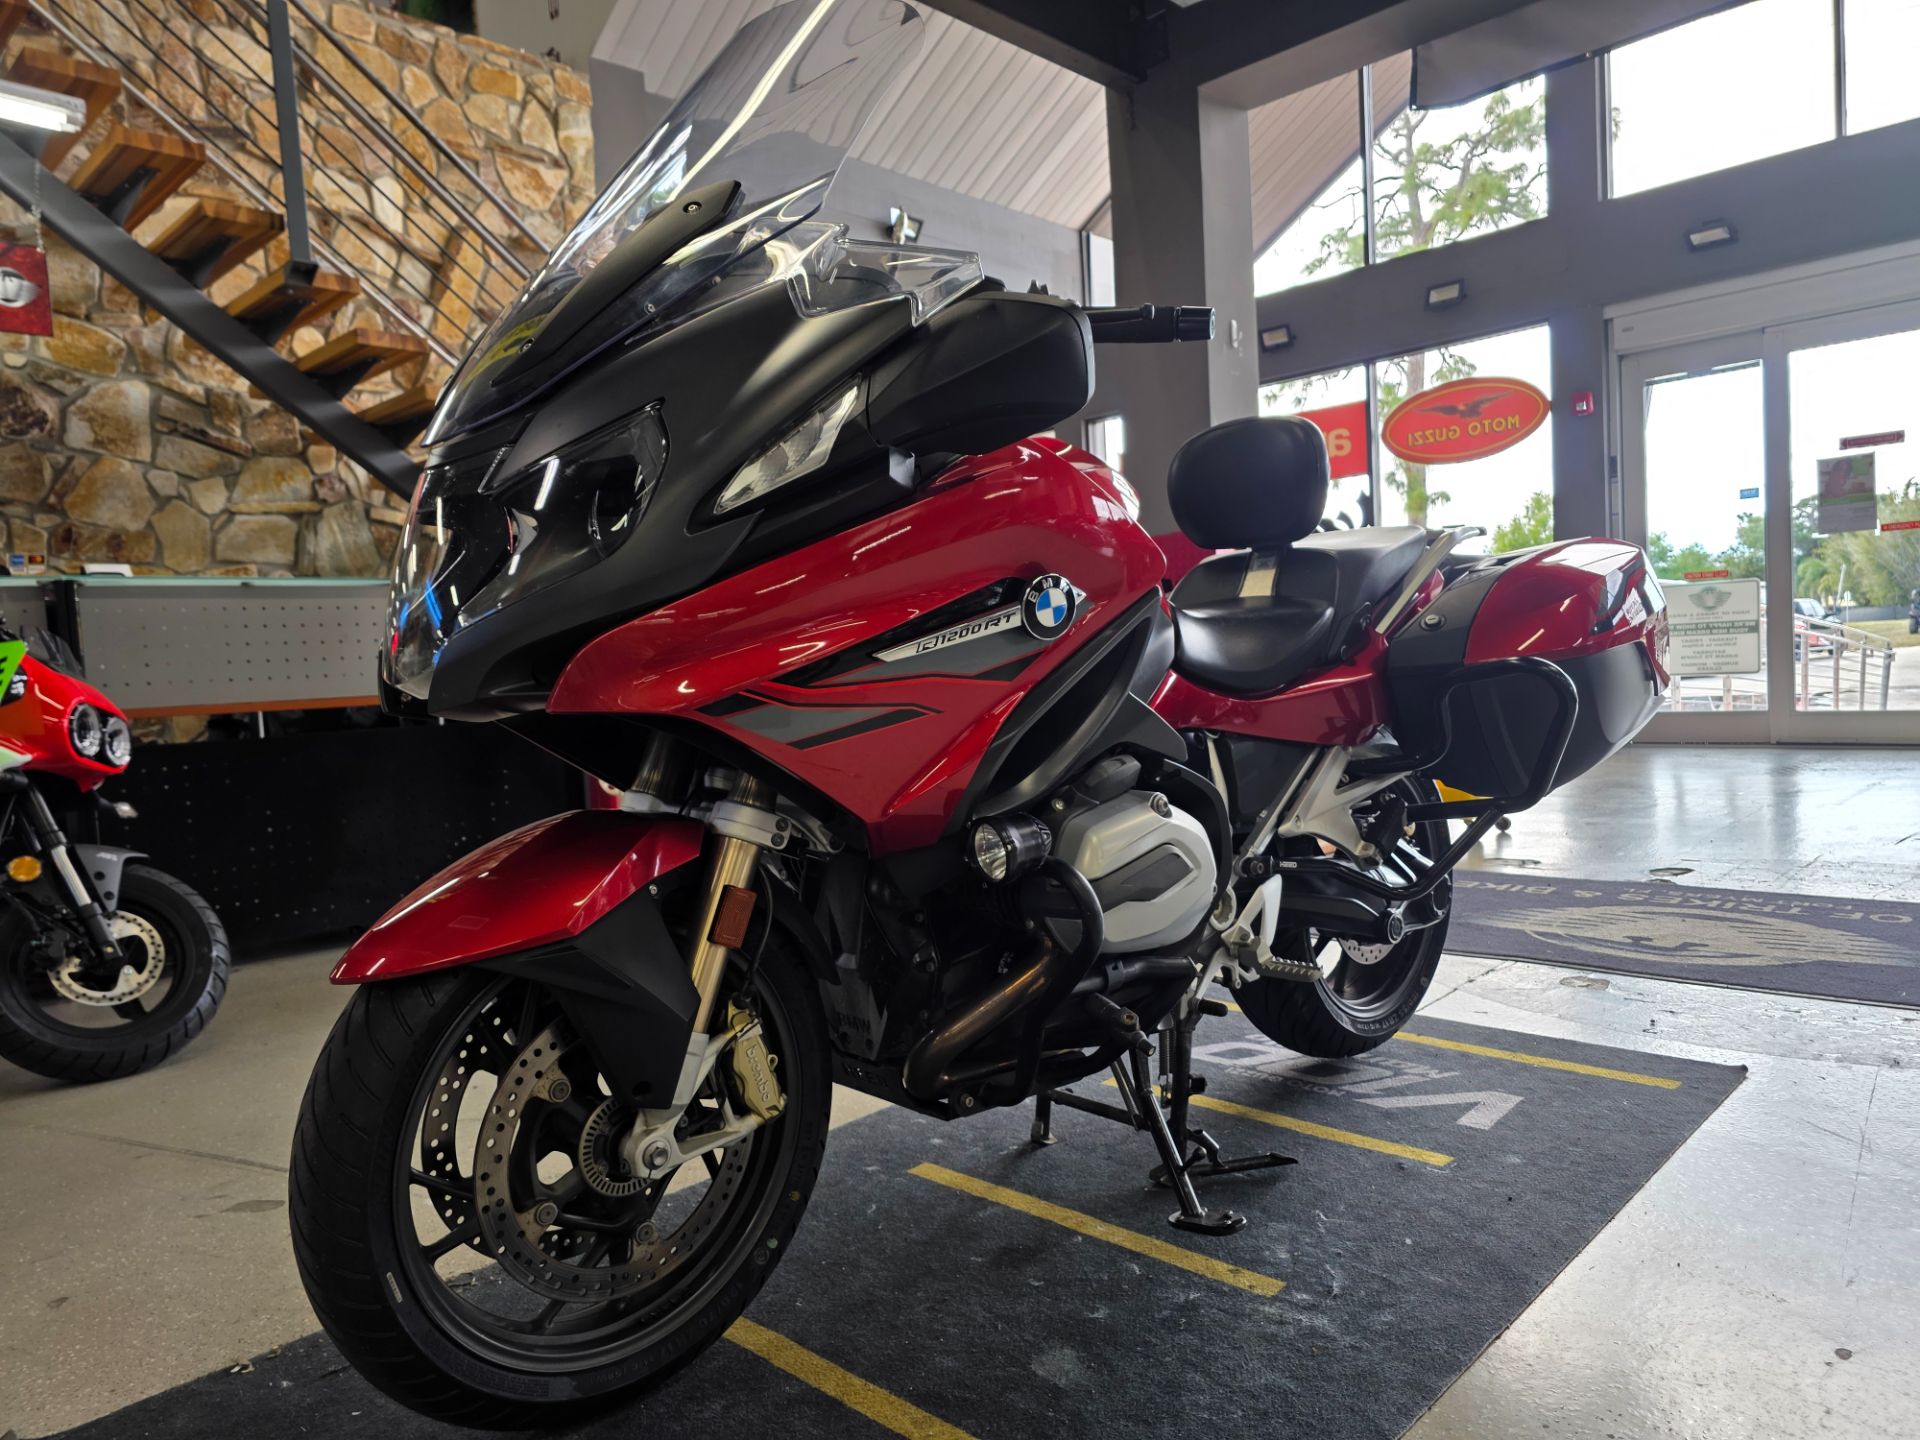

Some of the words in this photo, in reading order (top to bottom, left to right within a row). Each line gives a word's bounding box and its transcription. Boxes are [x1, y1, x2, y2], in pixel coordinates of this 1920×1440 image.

[1027, 577, 1071, 603] BMW
[1455, 880, 1557, 895] BIKE
[1573, 889, 1602, 898] &
[1617, 892, 1808, 915] TRIKES
[1829, 911, 1913, 925] OF
[746, 1043, 771, 1102] brembo
